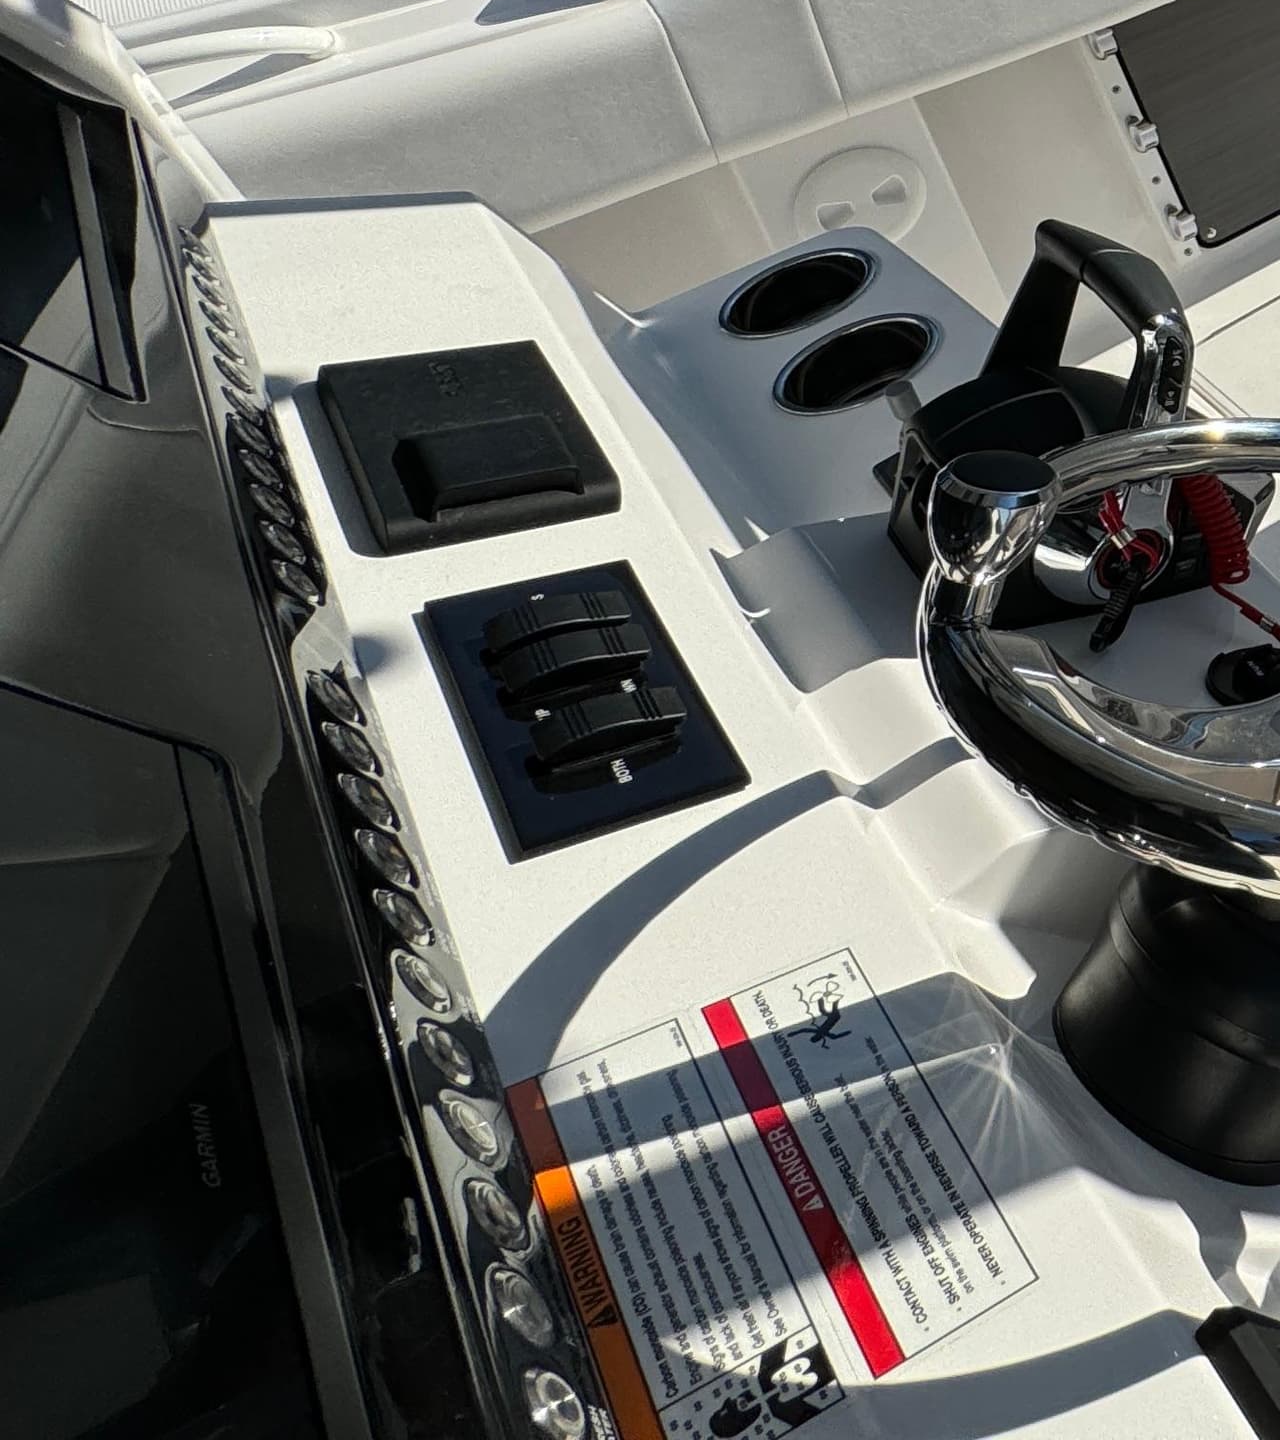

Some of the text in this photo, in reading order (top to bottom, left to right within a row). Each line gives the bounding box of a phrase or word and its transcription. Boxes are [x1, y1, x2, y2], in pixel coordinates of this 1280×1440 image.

[610, 758, 633, 784] BOTH
[763, 1016, 779, 1030] OR
[784, 1056, 812, 1095] SERIOUS
[881, 1071, 908, 1107] PERSON
[802, 1091, 827, 1125] CAUSE
[188, 1103, 222, 1189] GARMIN
[817, 1121, 837, 1145] WILL
[903, 1111, 932, 1151] TOWARD
[765, 1124, 816, 1199] DANGER
[828, 1142, 864, 1198] PROPELLER
[924, 1149, 955, 1192] REVERSE
[947, 1189, 961, 1203] IN
[854, 1194, 887, 1243] SPINNING
[904, 1212, 935, 1257] ENGINES
[952, 1199, 984, 1245] OPERATE
[555, 1214, 609, 1310] WARNING
[881, 1247, 904, 1277] WITH
[926, 1254, 945, 1277] OFF
[976, 1242, 1003, 1278] NEVER
[630, 1290, 652, 1317] (CO)
[895, 1274, 929, 1325] CONTACT
[937, 1275, 960, 1305] SHUT
[655, 1359, 679, 1399] Carbon
